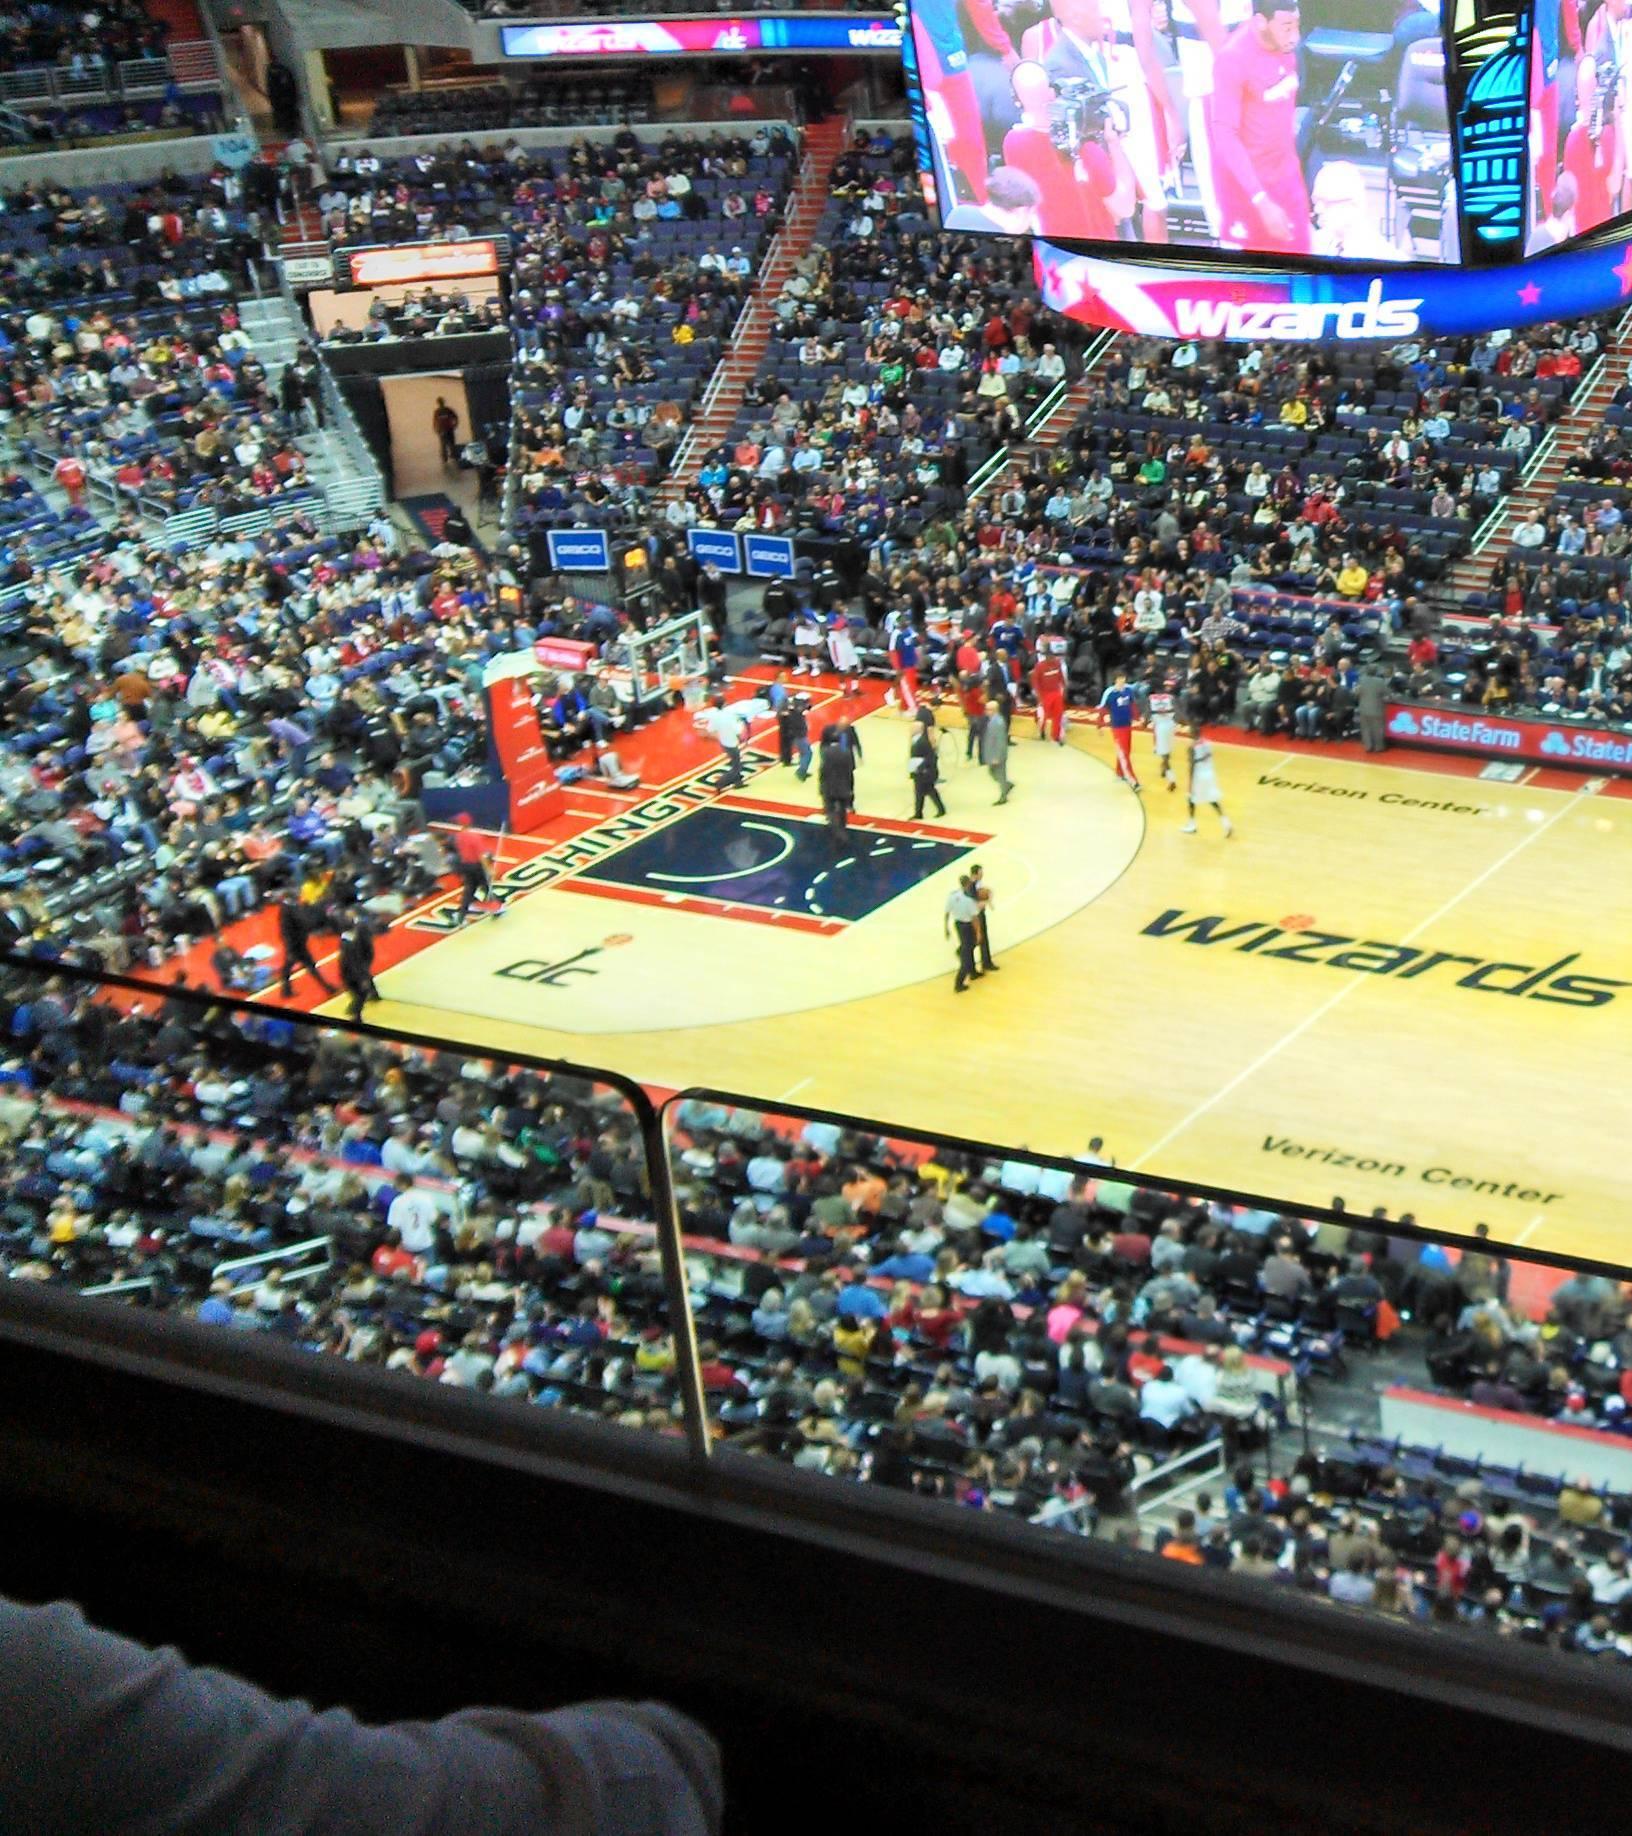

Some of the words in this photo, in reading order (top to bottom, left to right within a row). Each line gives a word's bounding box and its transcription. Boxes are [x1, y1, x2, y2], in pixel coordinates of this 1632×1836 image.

[1175, 277, 1425, 341] wizards
[556, 544, 601, 555] GEICO
[696, 543, 734, 557] GEICO
[751, 549, 789, 564] GEICO
[1256, 775, 1368, 801] Verizon
[1378, 792, 1488, 817] Center
[411, 750, 777, 930] WASHINGTON
[1261, 1134, 1406, 1178] Verizon
[1420, 1167, 1565, 1205] Center
